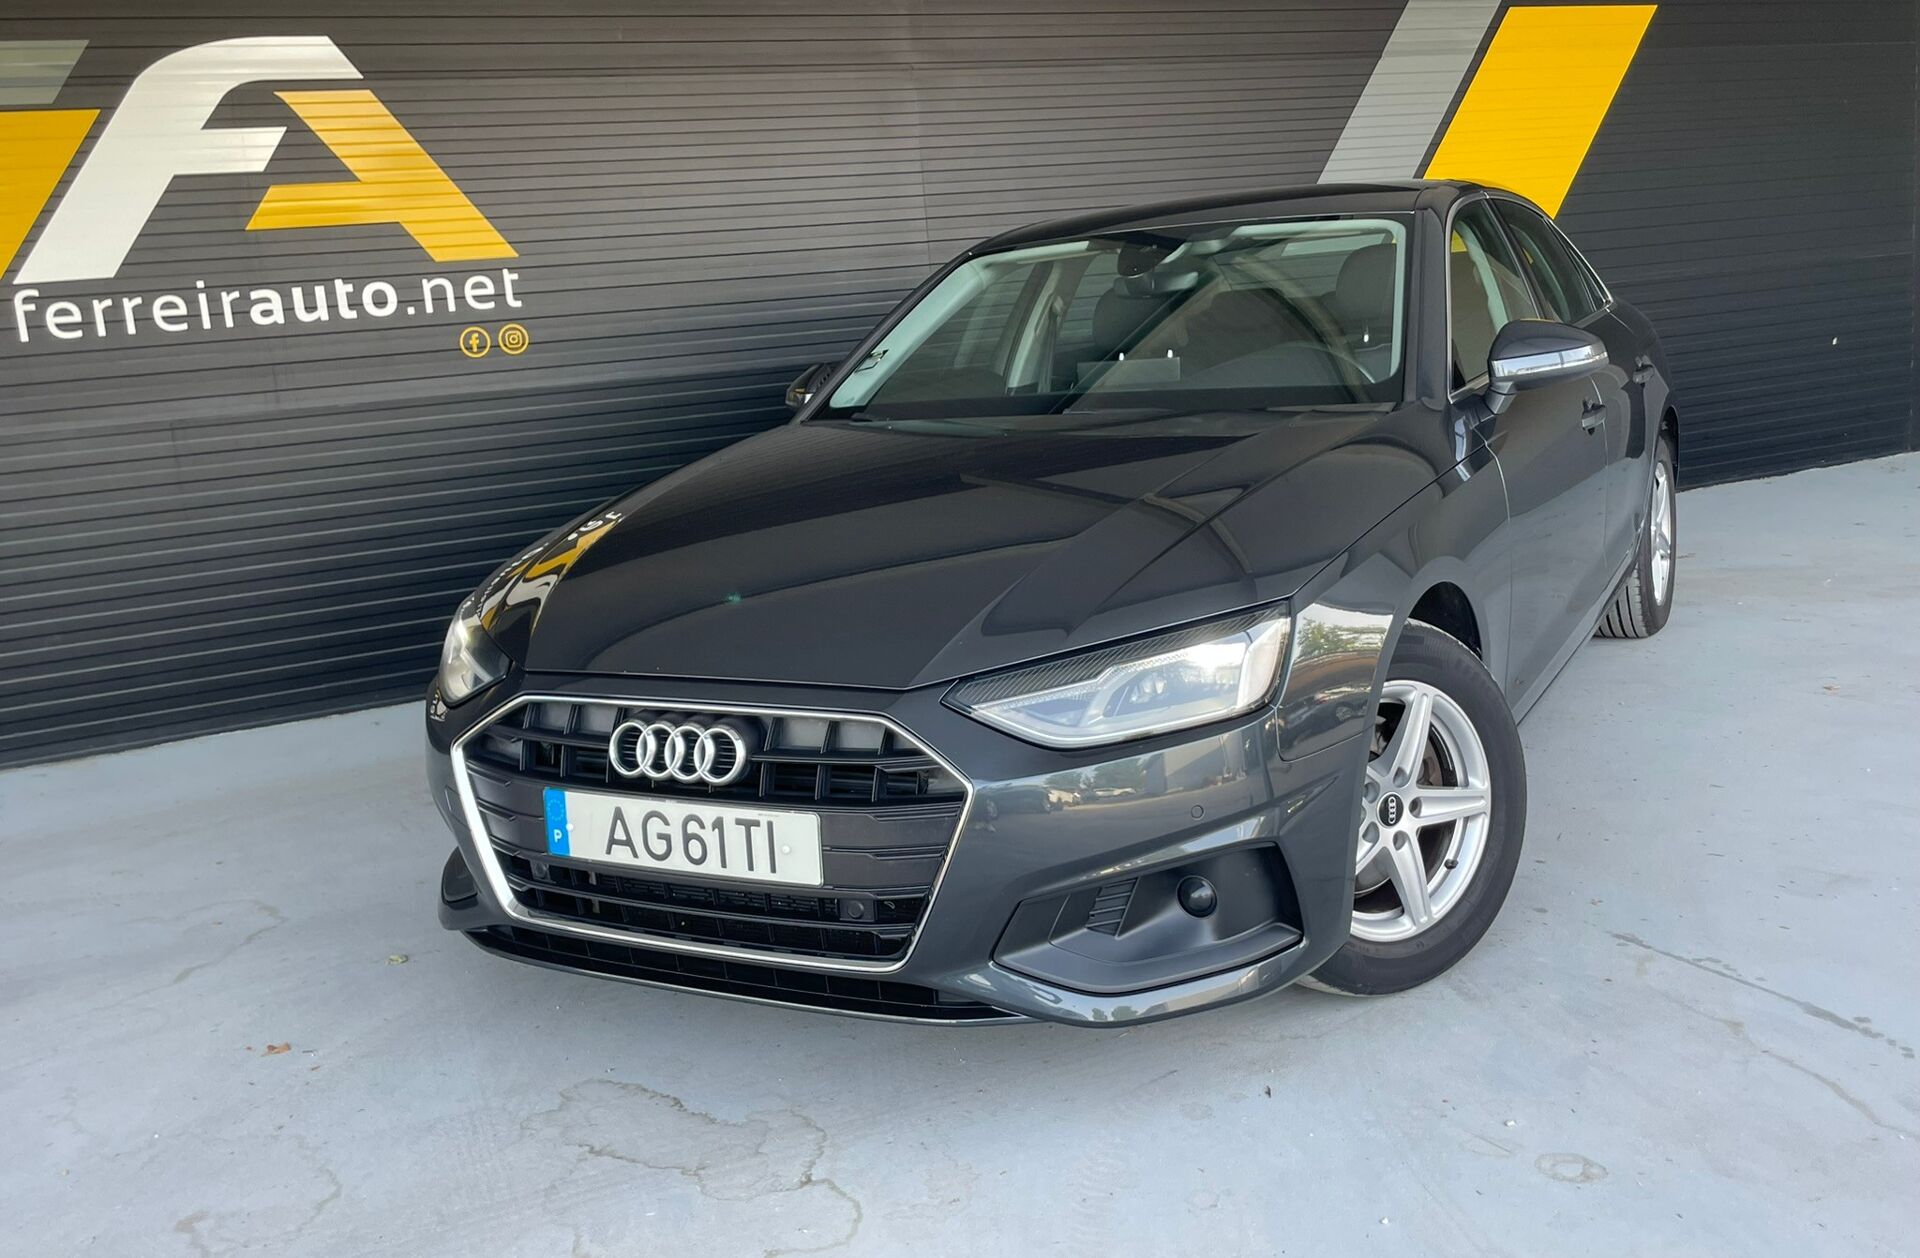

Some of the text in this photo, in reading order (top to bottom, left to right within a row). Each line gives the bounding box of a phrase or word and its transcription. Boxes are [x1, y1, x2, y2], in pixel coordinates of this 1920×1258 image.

[13, 267, 524, 343] ferreirauto.net
[553, 828, 563, 843] P
[605, 806, 777, 874] AG61TI
